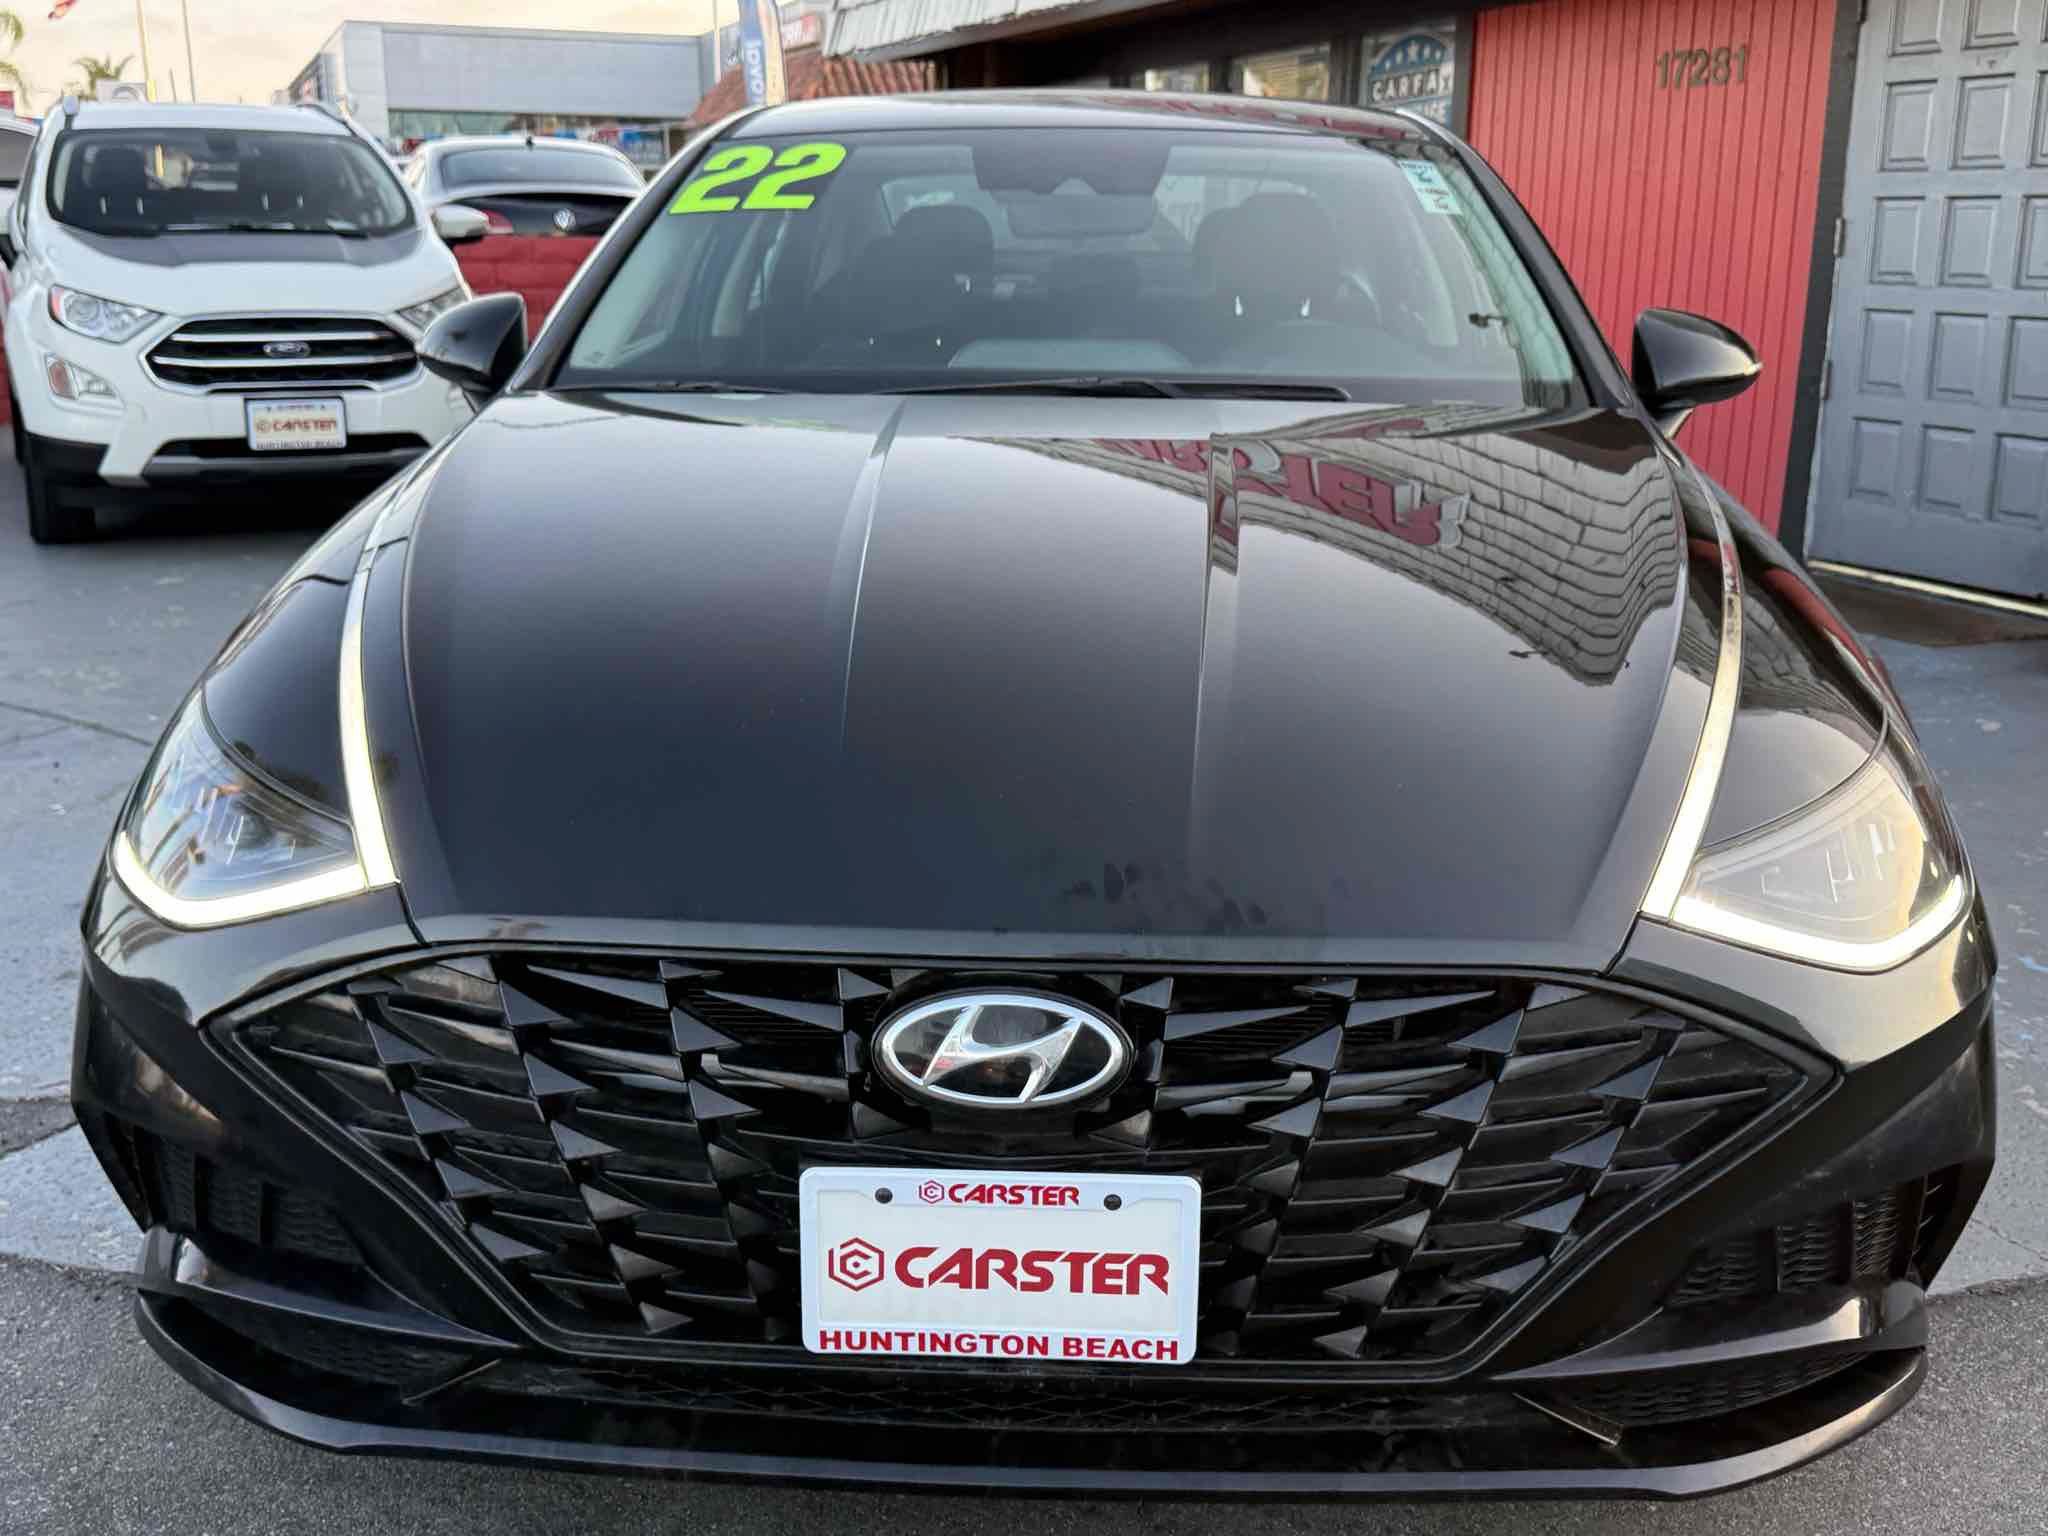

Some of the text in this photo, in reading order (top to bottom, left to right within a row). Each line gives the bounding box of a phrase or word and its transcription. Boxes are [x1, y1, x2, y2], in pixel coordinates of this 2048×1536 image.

[1372, 66, 1453, 101] CARFAX
[1657, 47, 1745, 89] 17281
[670, 143, 846, 213] 22
[948, 1183, 1079, 1206] CARSTER
[894, 1246, 1170, 1297] CARSTER
[819, 1330, 1178, 1361] HUNTINGTON BEACH
